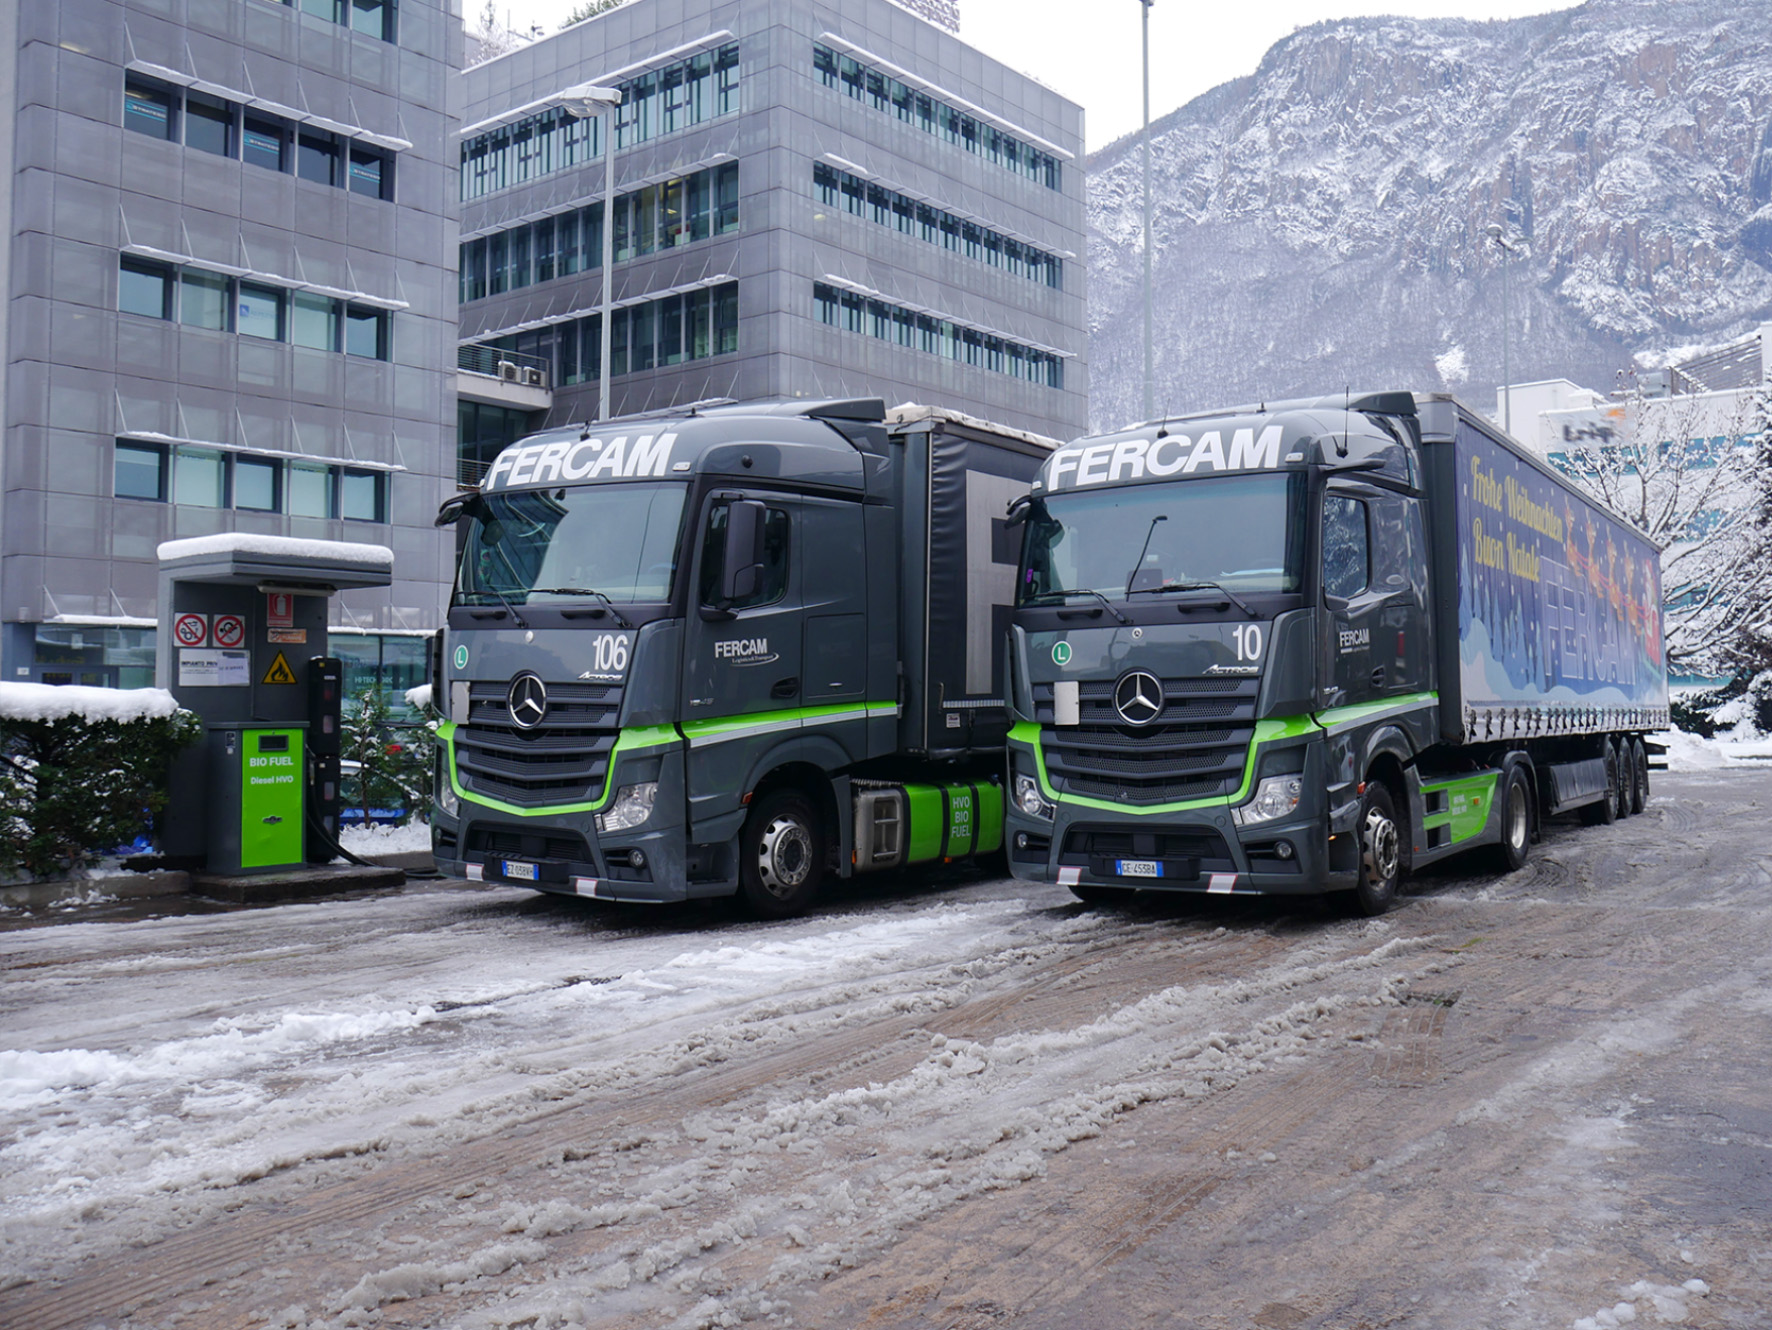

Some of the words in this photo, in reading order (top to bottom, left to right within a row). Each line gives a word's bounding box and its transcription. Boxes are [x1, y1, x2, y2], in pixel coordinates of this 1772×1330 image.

[486, 433, 679, 491] FERCAM
[1048, 425, 1284, 492] FERCAM
[1473, 517, 1504, 571] Buon
[1506, 532, 1540, 583] Natale
[1232, 624, 1262, 661] 10
[1339, 628, 1370, 647] FERCAM
[592, 634, 628, 671] 106
[714, 638, 768, 658] FERCAM
[249, 757, 267, 767] BIO
[269, 756, 294, 766] FUEL
[250, 776, 275, 785] Diesel
[275, 775, 294, 784] HVO
[952, 796, 970, 809] HVO
[954, 810, 969, 823] BIO
[951, 825, 971, 838] FUEL
